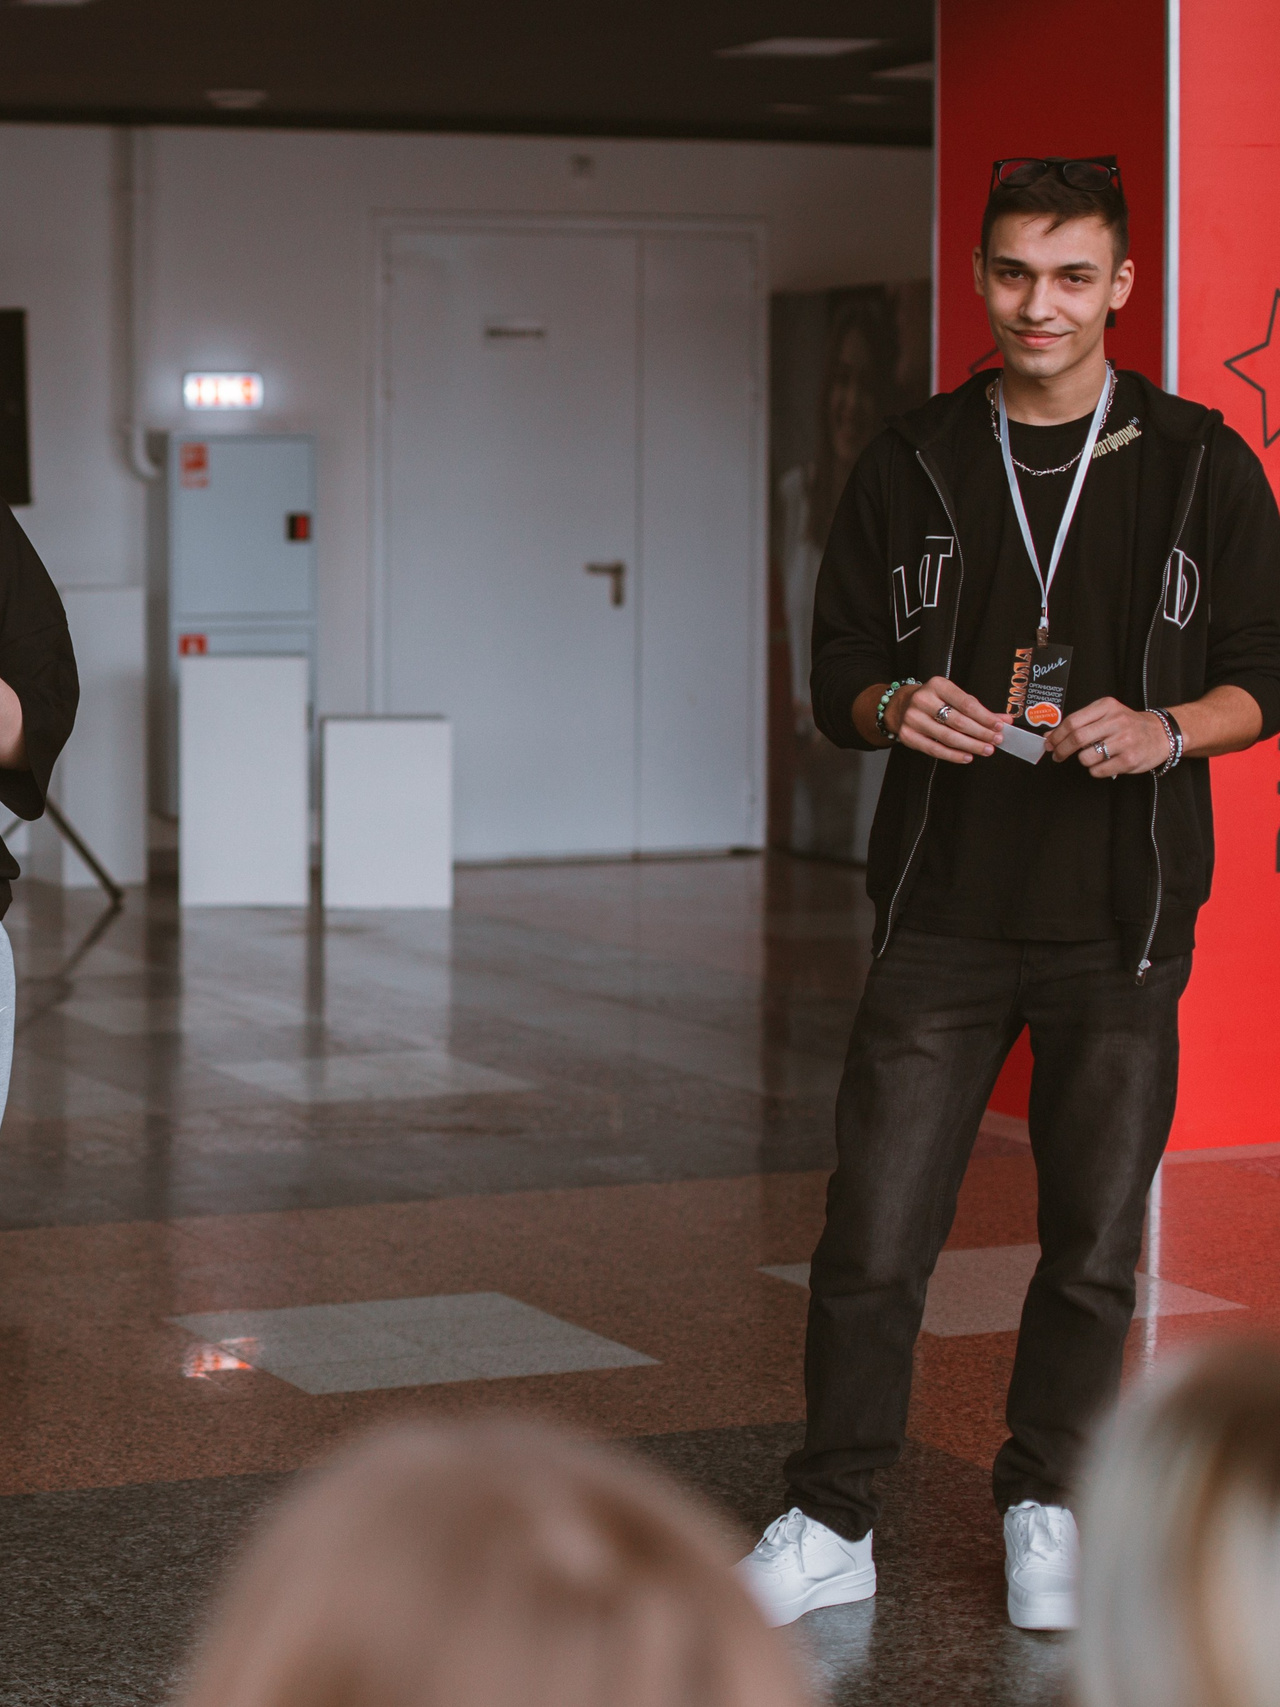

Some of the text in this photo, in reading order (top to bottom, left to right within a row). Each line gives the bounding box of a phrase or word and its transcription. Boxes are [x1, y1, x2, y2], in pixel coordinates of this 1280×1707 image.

[1092, 424, 1142, 459] латформа.
[1029, 683, 1064, 692] ОРГАНИЗАТОР
[1028, 688, 1063, 697] ОРГАНИЗАТОР
[1027, 694, 1062, 703] ОРГАНИЗАТОР
